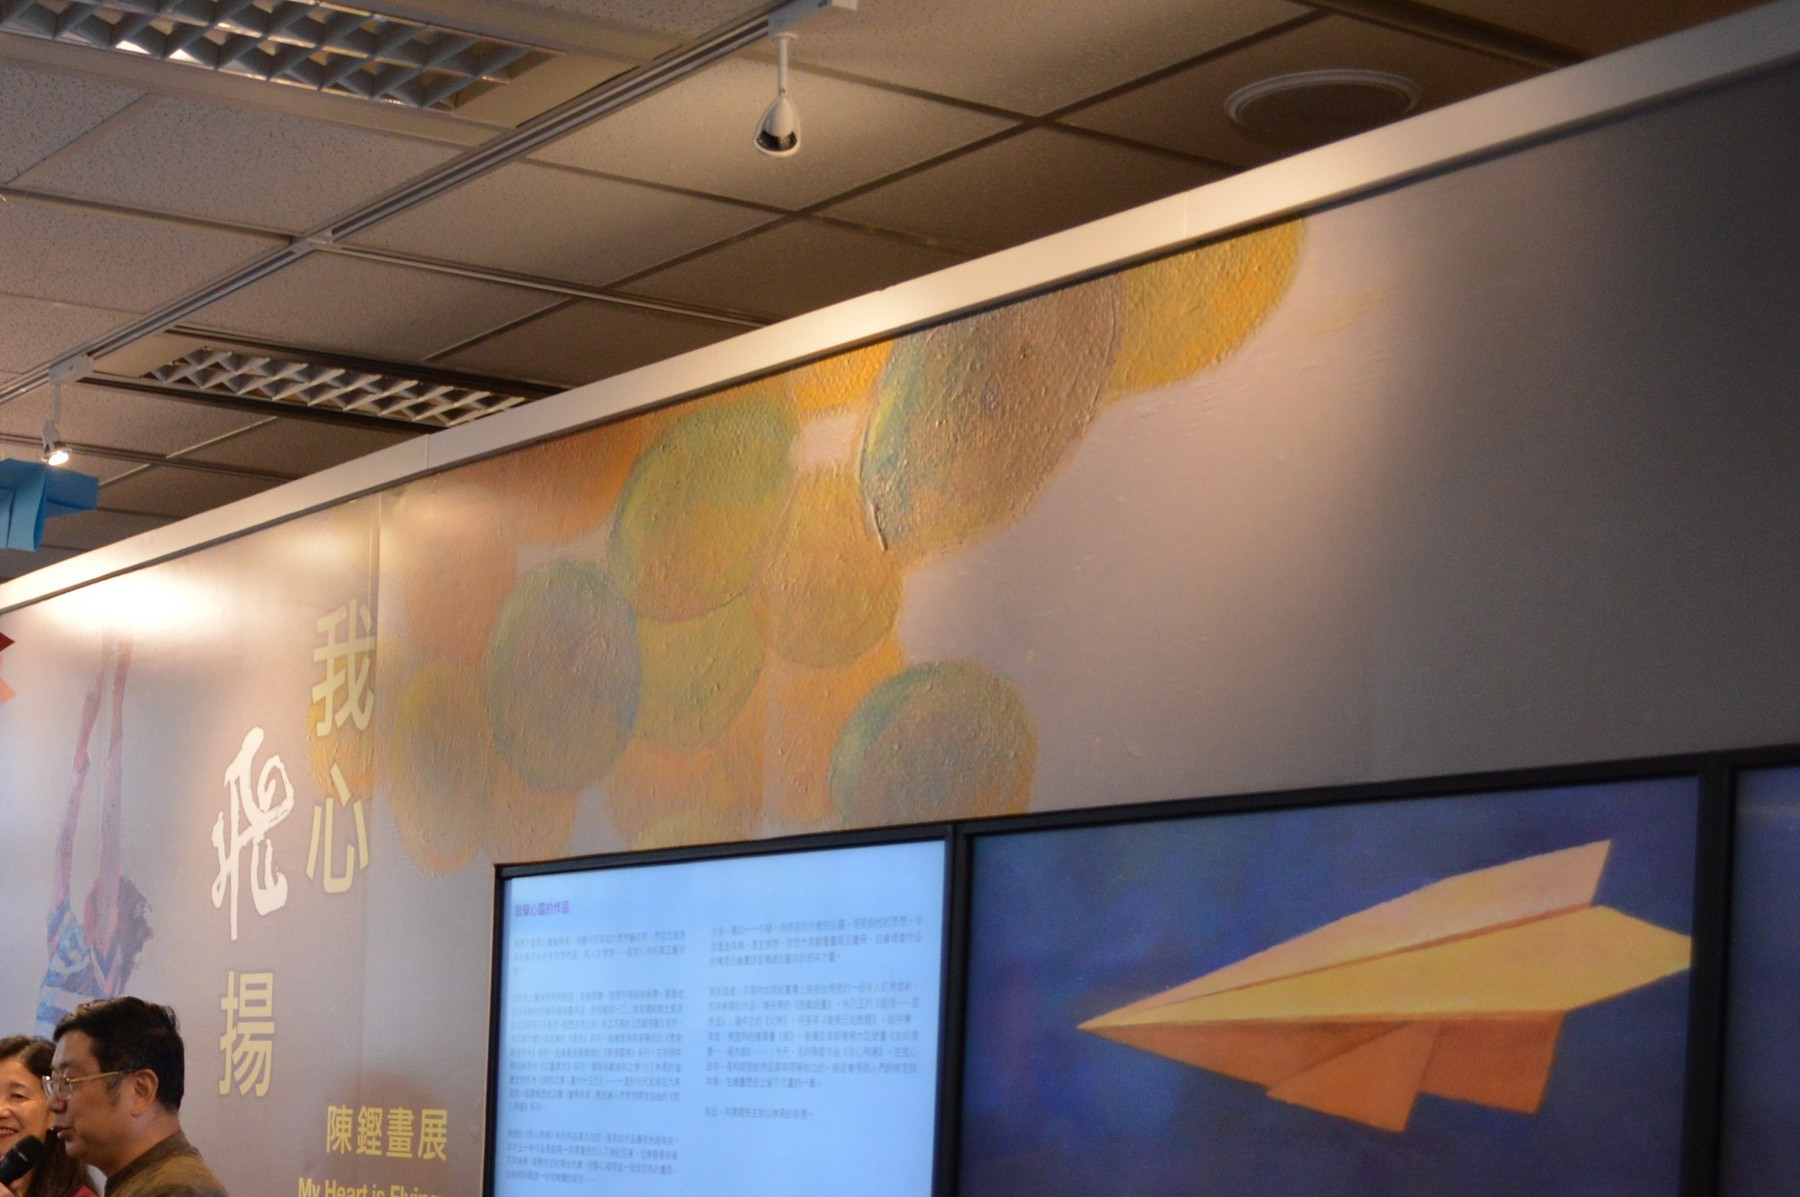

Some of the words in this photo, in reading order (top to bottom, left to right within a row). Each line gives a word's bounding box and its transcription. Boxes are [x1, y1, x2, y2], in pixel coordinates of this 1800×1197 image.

[305, 597, 375, 894] 我心
[326, 1104, 448, 1160] 陳鏗畫展
